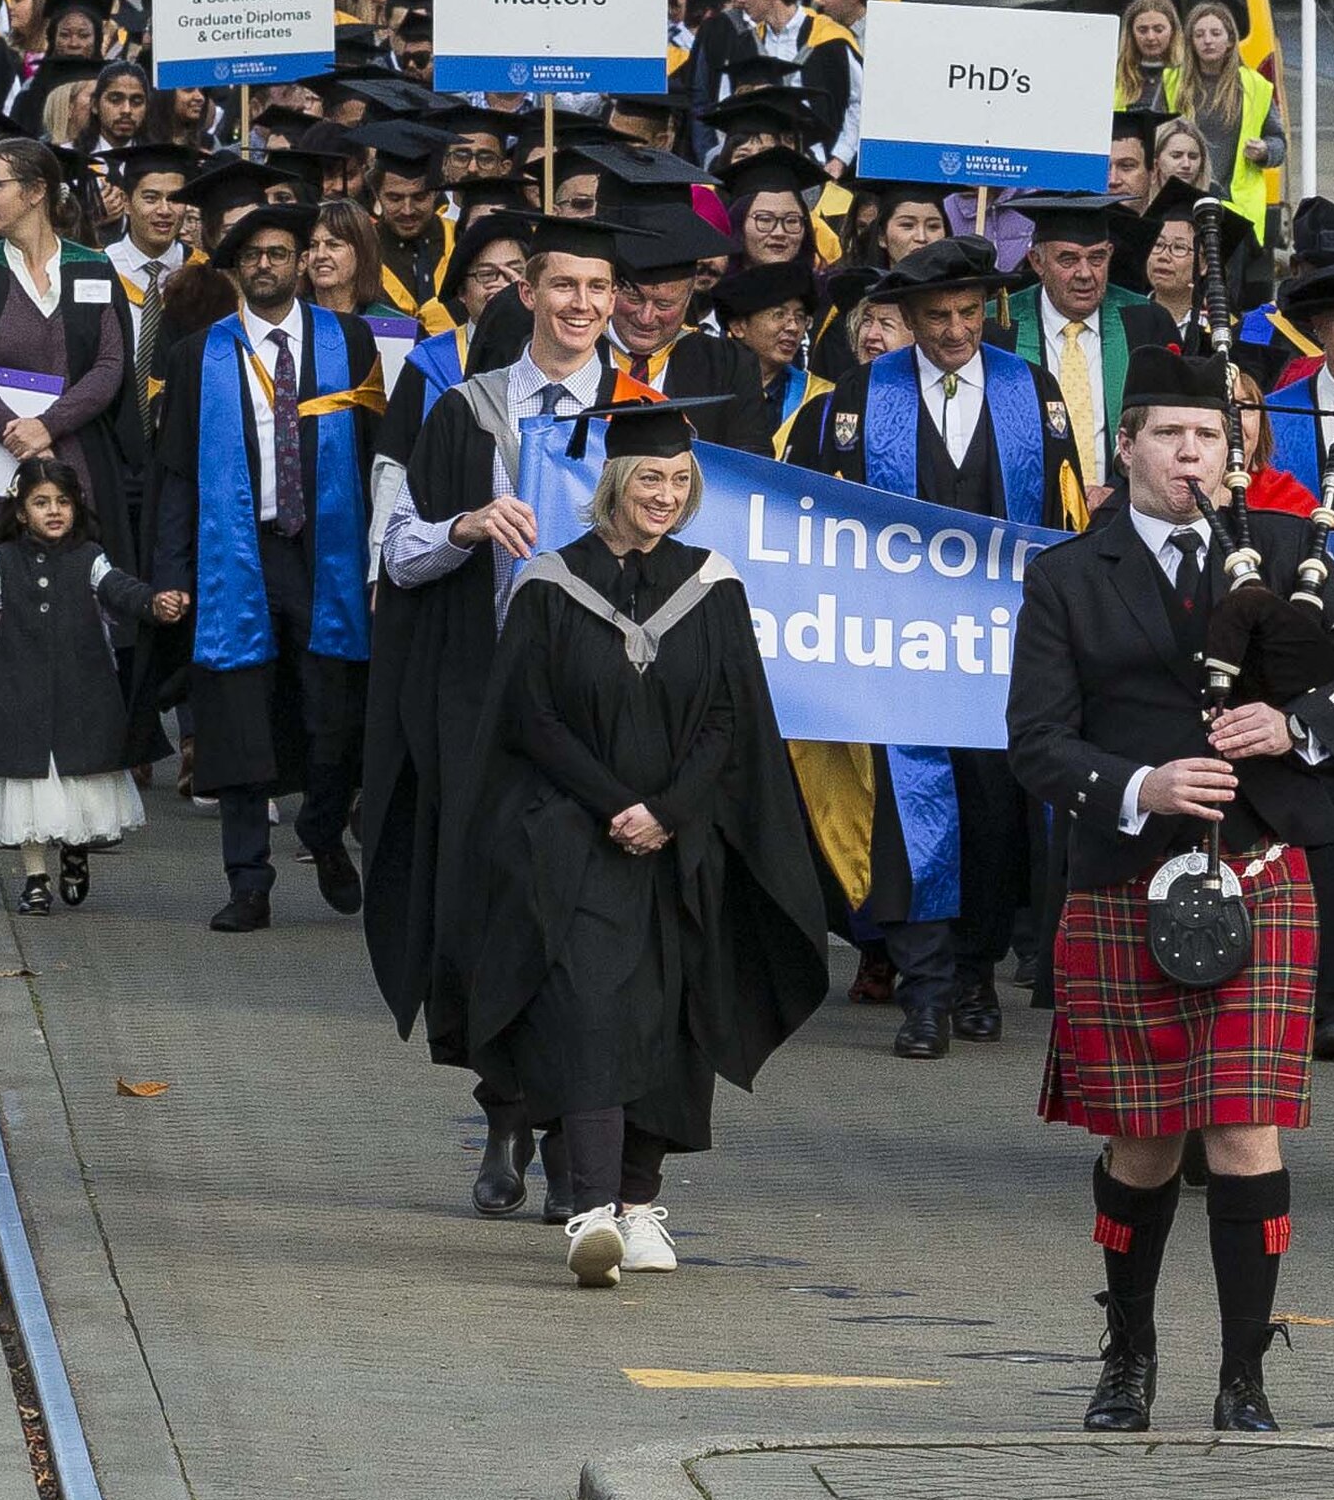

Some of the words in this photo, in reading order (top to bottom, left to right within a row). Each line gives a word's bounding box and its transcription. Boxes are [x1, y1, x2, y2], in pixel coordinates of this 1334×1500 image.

[178, 13, 243, 28] Graduate
[246, 9, 312, 25] Diplomas
[197, 31, 208, 43] &
[211, 27, 293, 42] Certificates
[532, 71, 592, 79] UNIVERSITY
[965, 154, 1010, 164] LINCOLN
[965, 162, 1029, 174] UNIVERSITY
